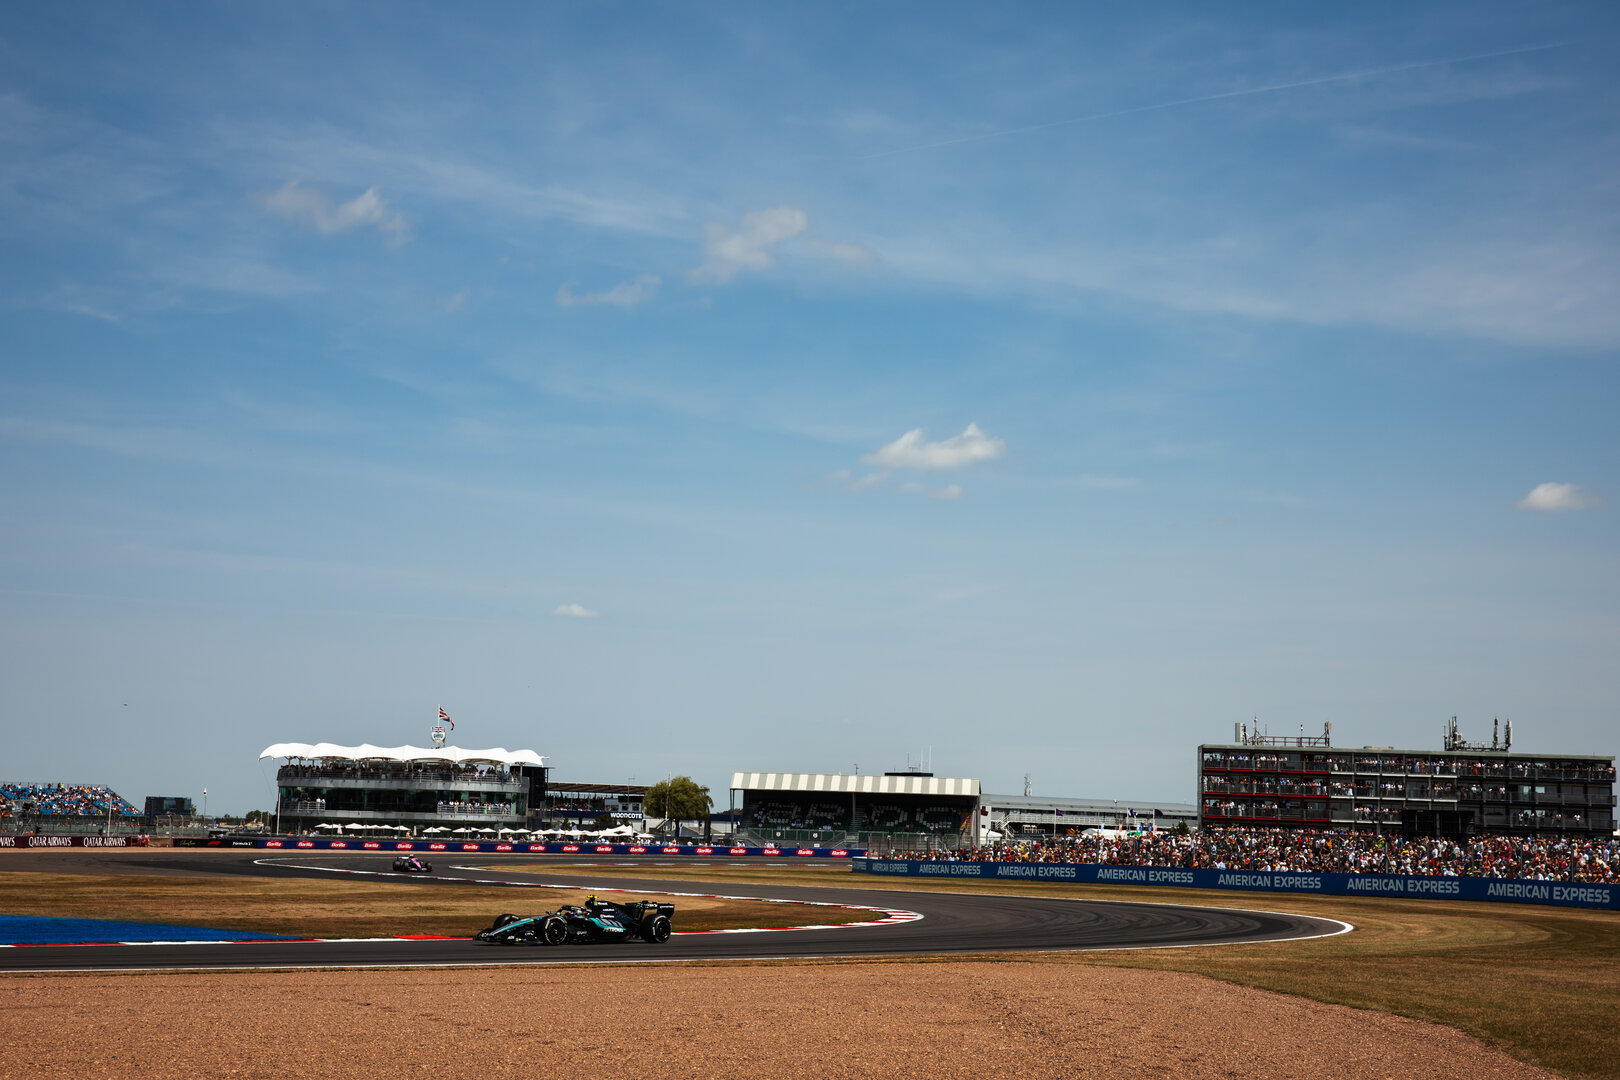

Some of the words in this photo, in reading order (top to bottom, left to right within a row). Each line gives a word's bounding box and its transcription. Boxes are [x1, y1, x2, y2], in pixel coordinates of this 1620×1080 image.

[29, 837, 47, 847] QATAR
[48, 837, 71, 847] AIRWAYS
[84, 837, 102, 847] QATAR
[103, 837, 126, 847] AIRWAYS
[919, 864, 949, 874] AMERICAN
[951, 865, 981, 875] EXPRESS
[997, 866, 1036, 876] AMERICAN
[1038, 867, 1076, 878] EXPRESS
[1097, 869, 1146, 881] AMERICAN
[1149, 870, 1194, 883] EXPRESS
[1218, 873, 1271, 887] AMERICAN
[1274, 876, 1321, 889] EXPRESS
[1347, 878, 1404, 892] AMERICAN
[1407, 880, 1459, 894] EXPRESS
[1487, 883, 1549, 899] AMERICAN
[1553, 886, 1610, 903] EXPRESS
